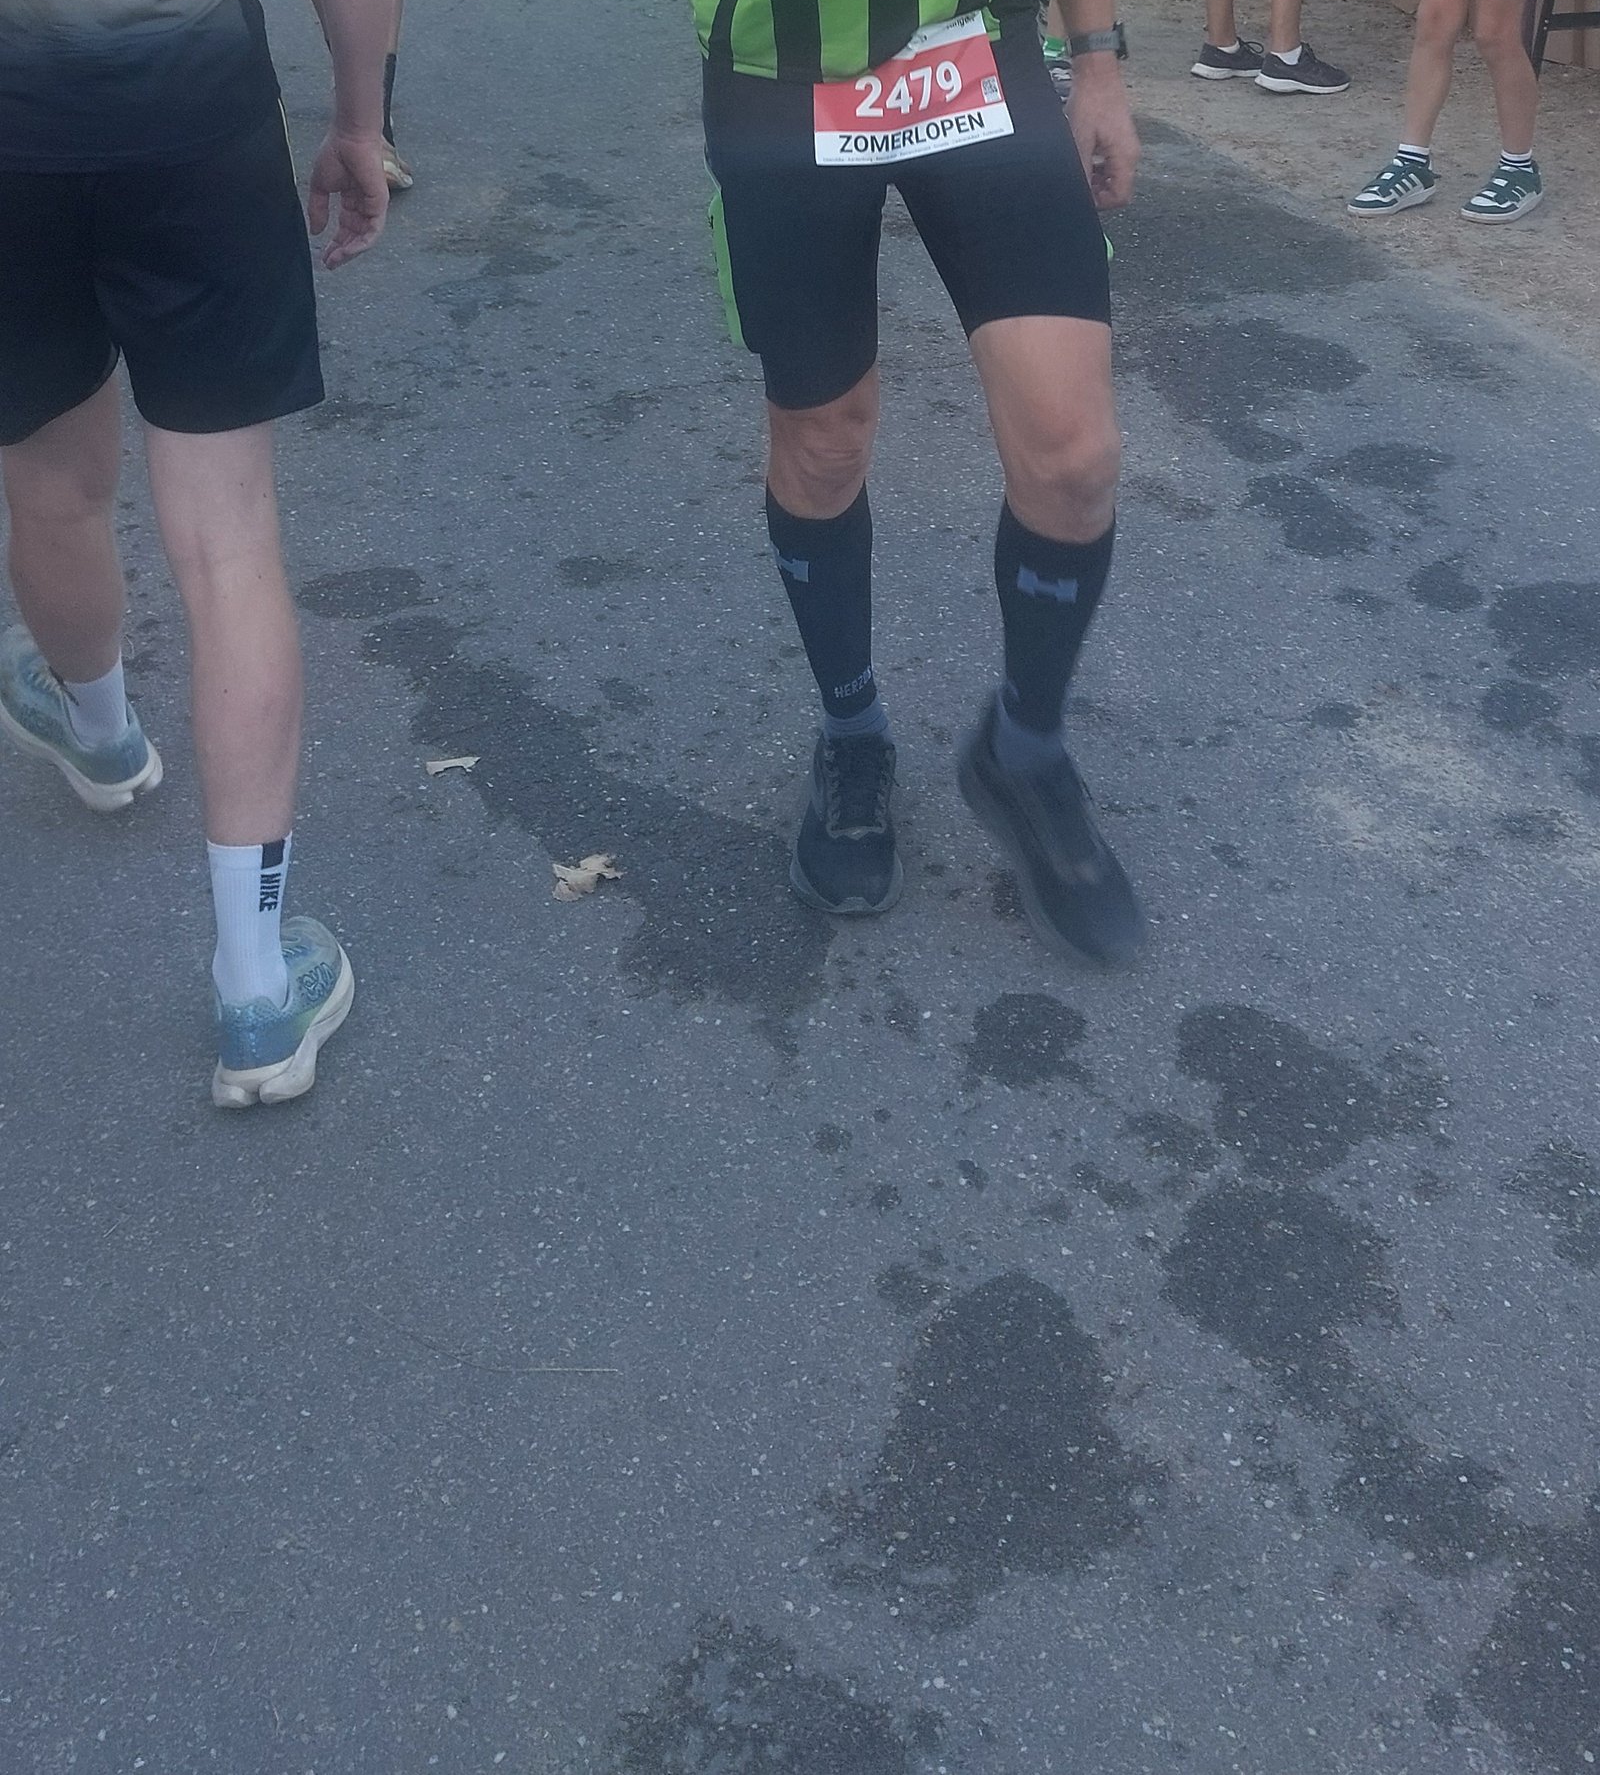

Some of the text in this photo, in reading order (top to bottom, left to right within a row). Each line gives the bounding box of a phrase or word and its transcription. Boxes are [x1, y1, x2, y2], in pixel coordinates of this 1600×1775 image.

[855, 61, 962, 118] 2479
[838, 111, 985, 154] ZOMERLOPEN
[259, 873, 281, 913] NIKE
